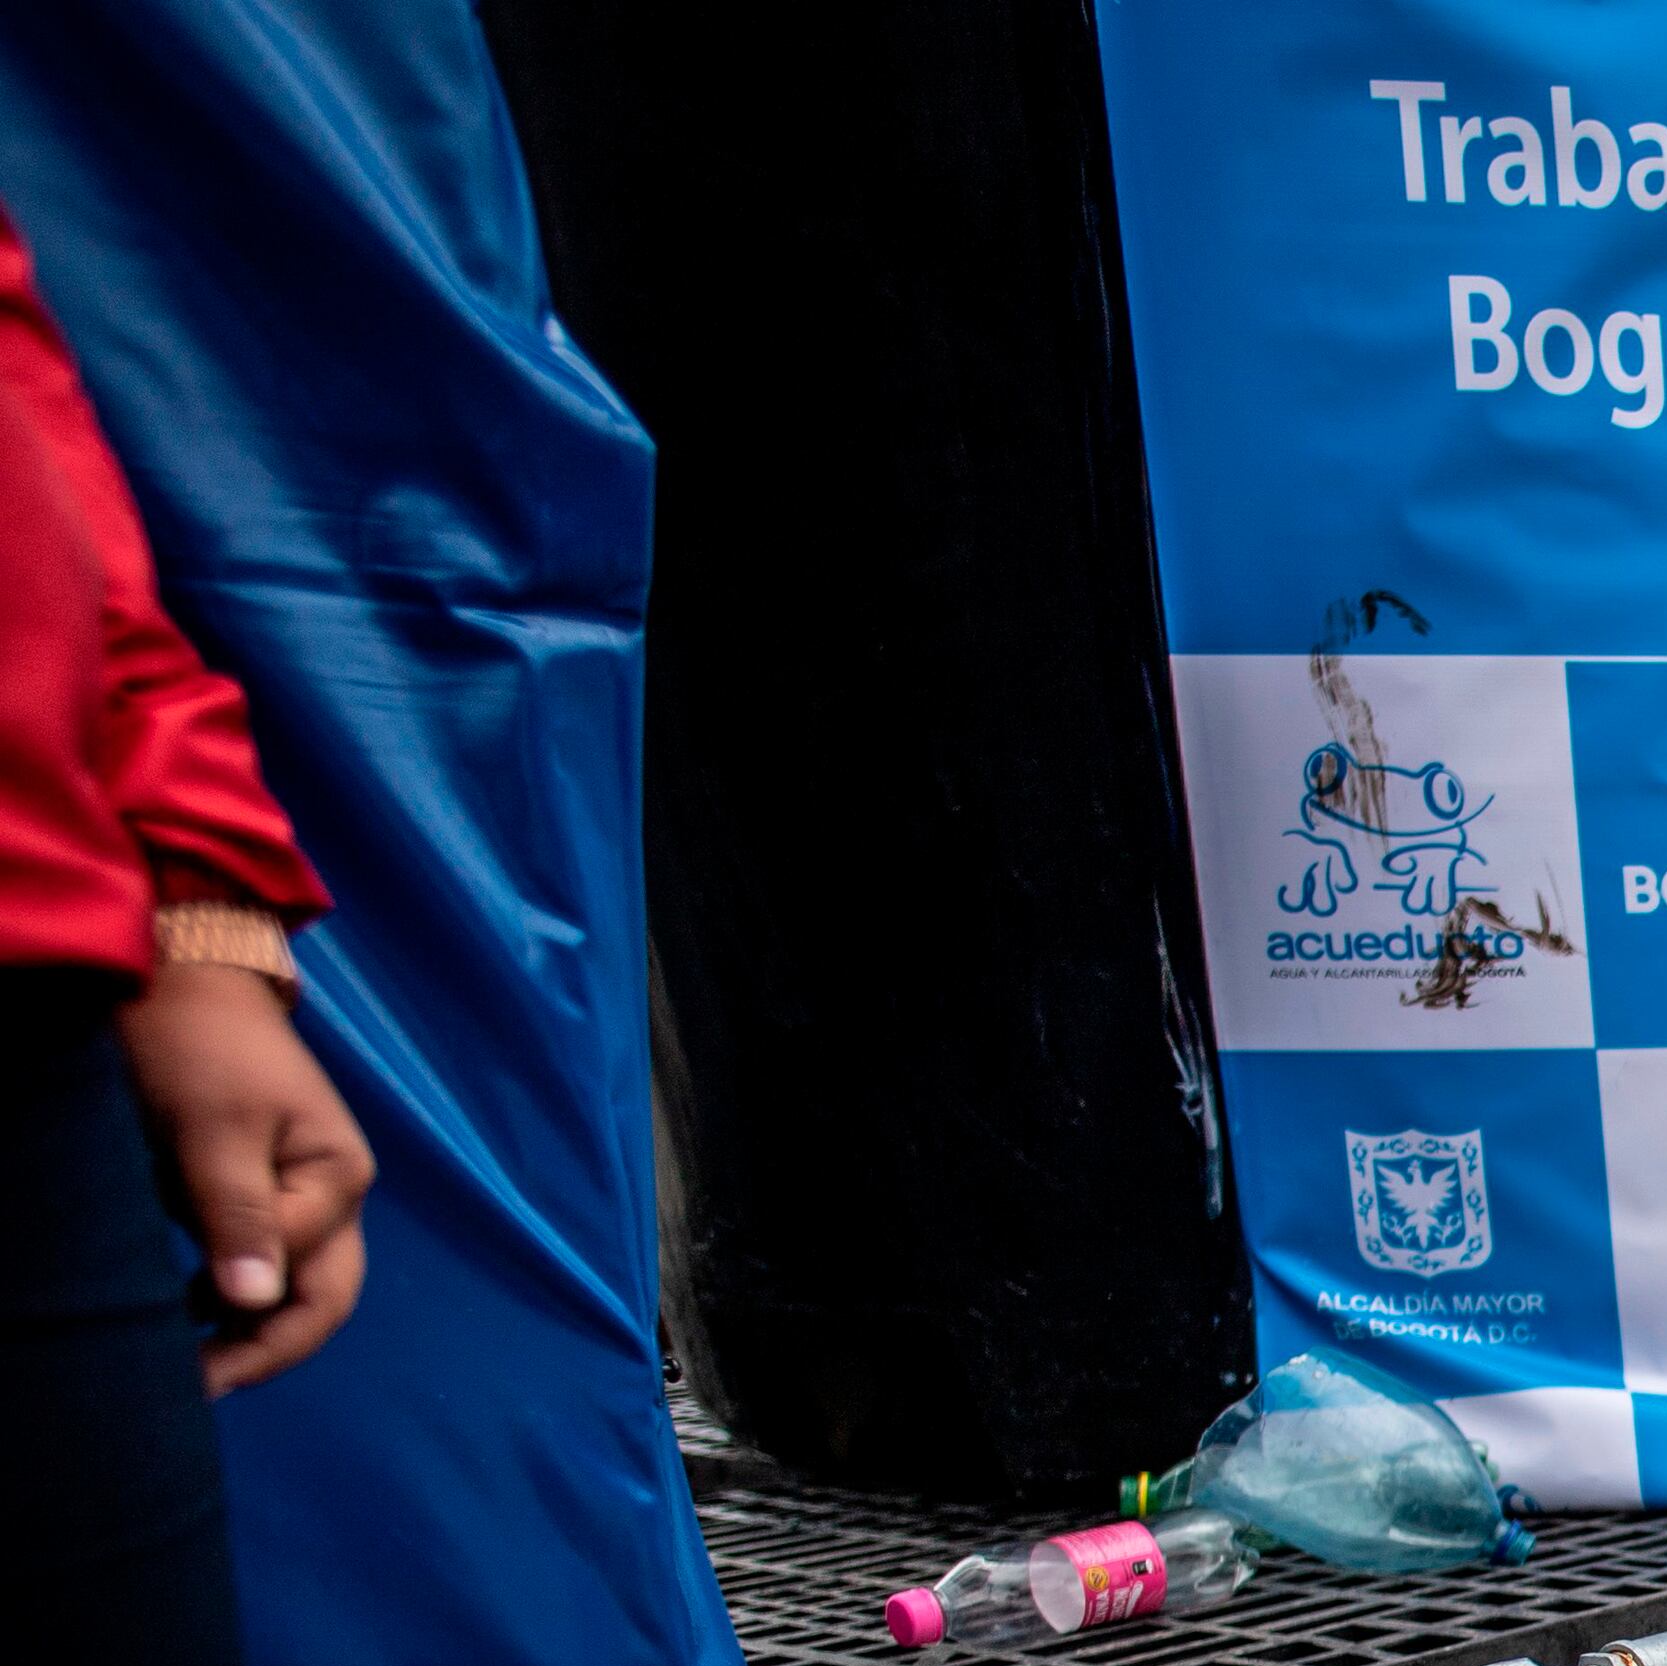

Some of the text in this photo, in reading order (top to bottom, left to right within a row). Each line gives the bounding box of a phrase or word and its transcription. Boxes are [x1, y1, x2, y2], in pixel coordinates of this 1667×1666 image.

[1267, 923, 1525, 962] acueducto
[1452, 1293, 1545, 1315] MAYOR
[1368, 1316, 1482, 1344] BOGOTÁ
